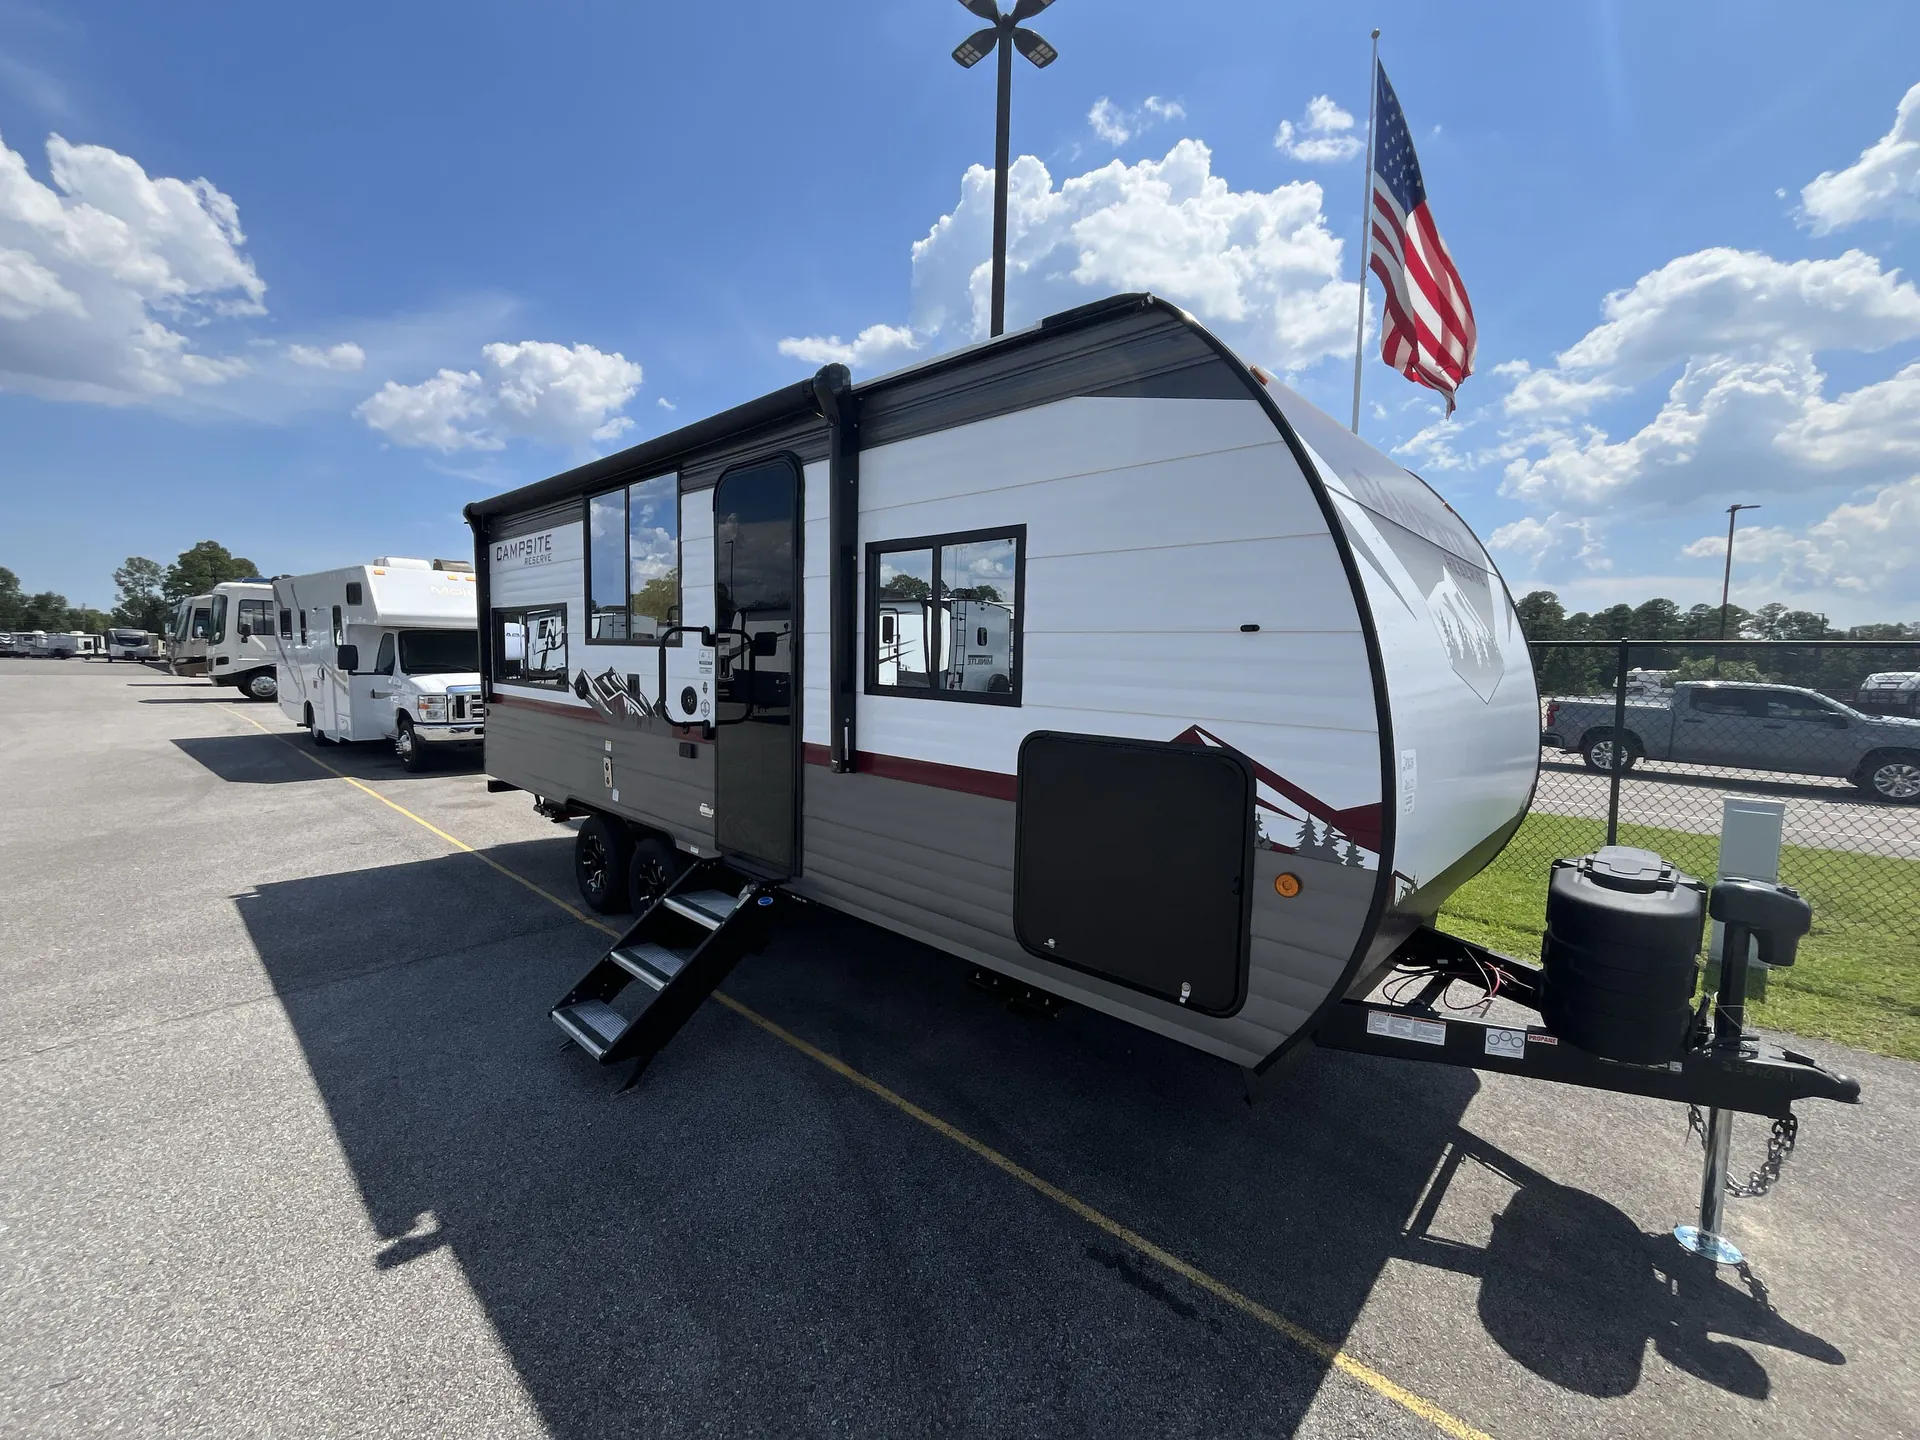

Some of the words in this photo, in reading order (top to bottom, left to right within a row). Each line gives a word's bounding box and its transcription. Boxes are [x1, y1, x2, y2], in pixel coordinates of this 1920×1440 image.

[496, 533, 552, 562] CAMPSITE
[524, 552, 552, 565] RESERVE
[1528, 1034, 1557, 1044] PROPANE
